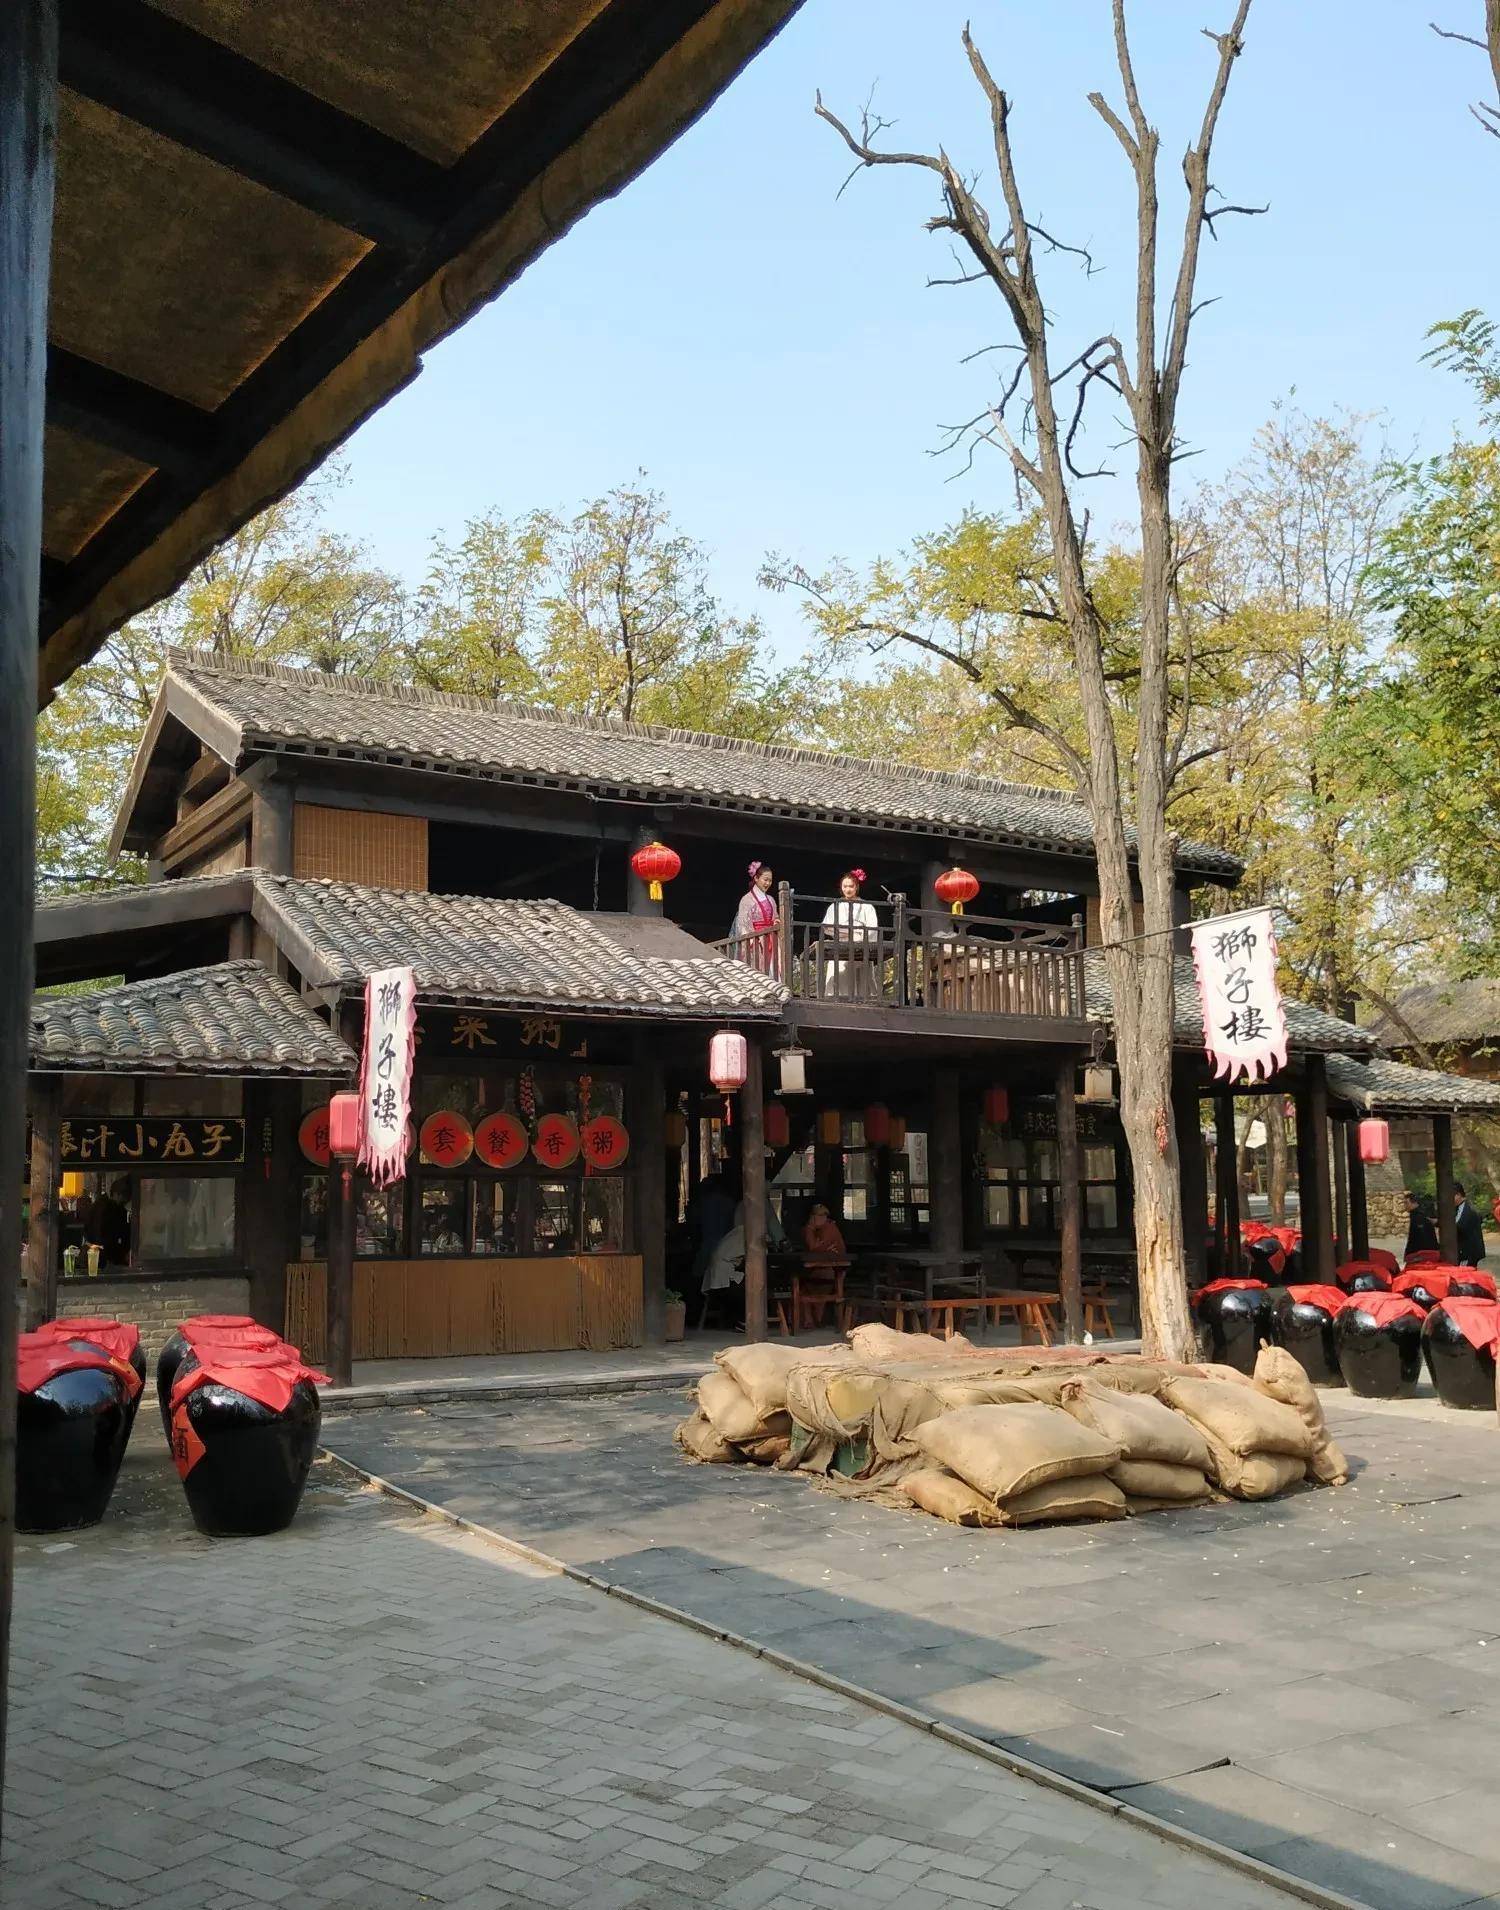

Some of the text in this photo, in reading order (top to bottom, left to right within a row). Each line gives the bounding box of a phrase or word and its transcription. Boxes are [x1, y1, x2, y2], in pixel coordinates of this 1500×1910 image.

[415, 1015, 562, 1050] 米粥
[1211, 925, 1272, 1046] 獅子樓
[371, 981, 401, 1132] 獅子樓
